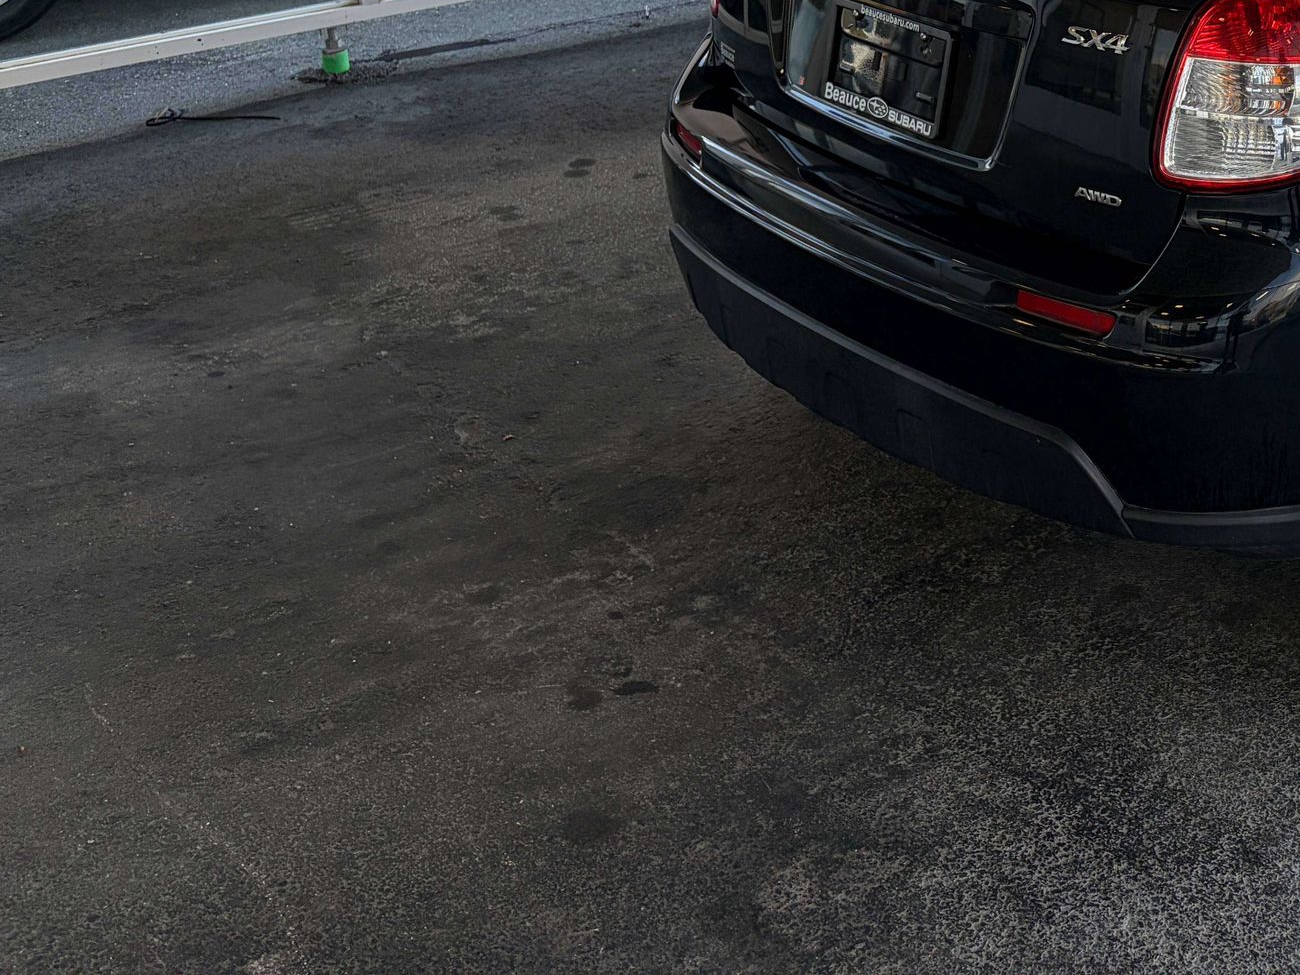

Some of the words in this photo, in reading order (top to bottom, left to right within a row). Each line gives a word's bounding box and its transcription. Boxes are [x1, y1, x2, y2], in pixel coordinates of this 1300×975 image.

[860, 4, 920, 33] beaucesubaru.com
[1061, 26, 1131, 55] SX4
[824, 81, 867, 112] Beauce
[887, 110, 932, 136] SUBARU
[1074, 186, 1122, 207] AWD
